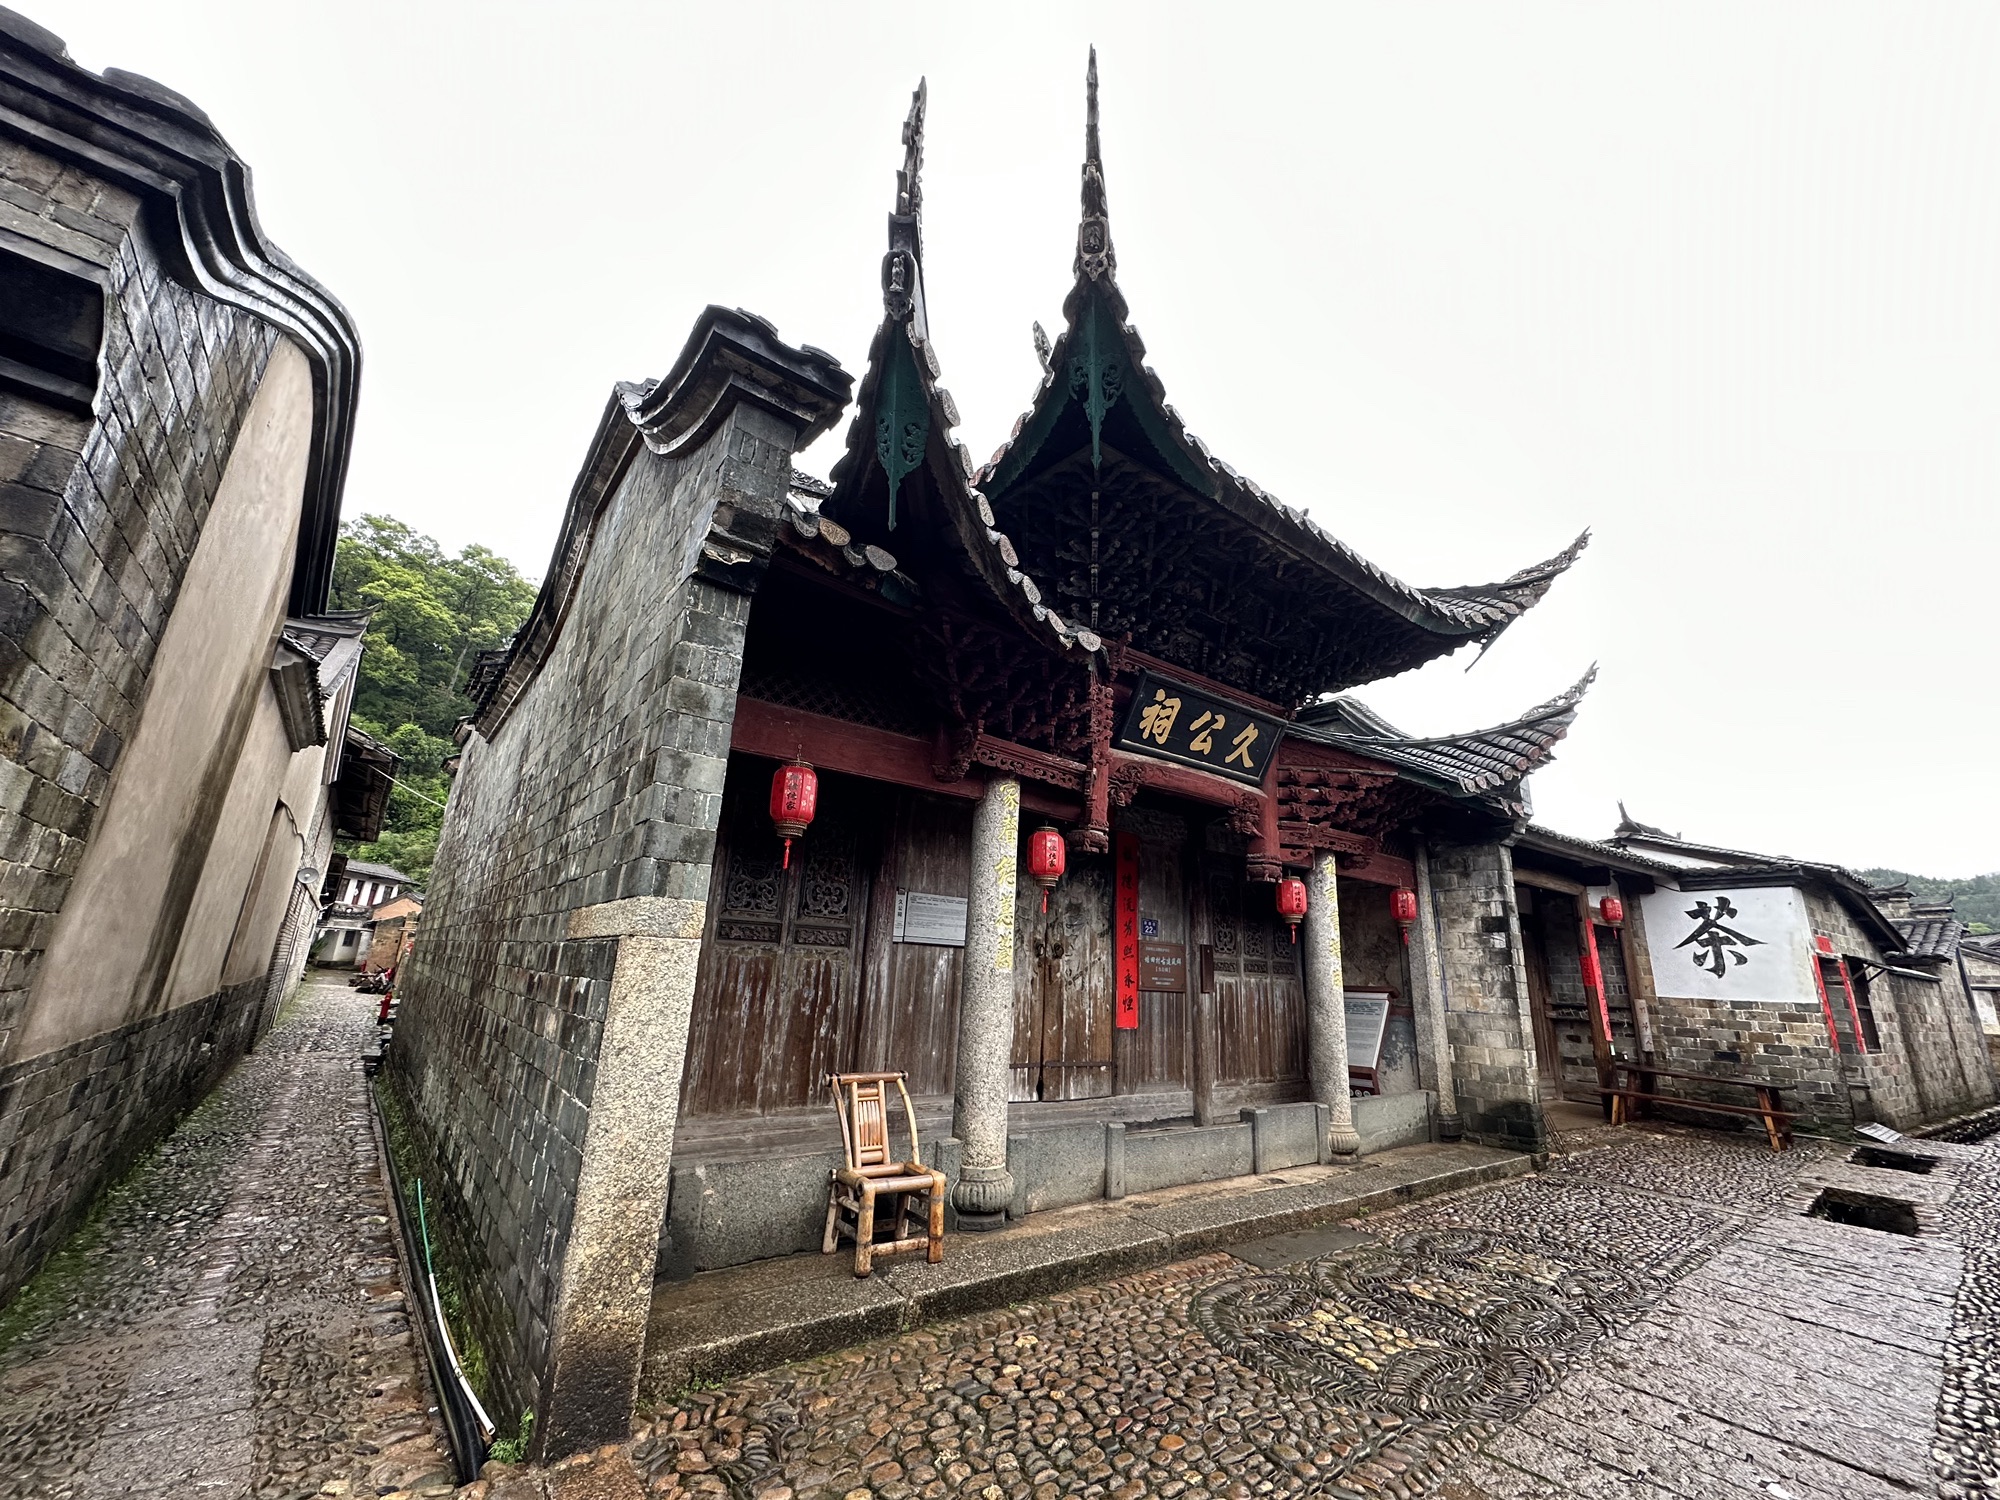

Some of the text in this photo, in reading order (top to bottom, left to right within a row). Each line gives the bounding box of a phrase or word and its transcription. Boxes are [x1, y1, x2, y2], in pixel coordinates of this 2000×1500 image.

[1139, 688, 1259, 768] 久公祠
[1672, 896, 1768, 979] 茶
